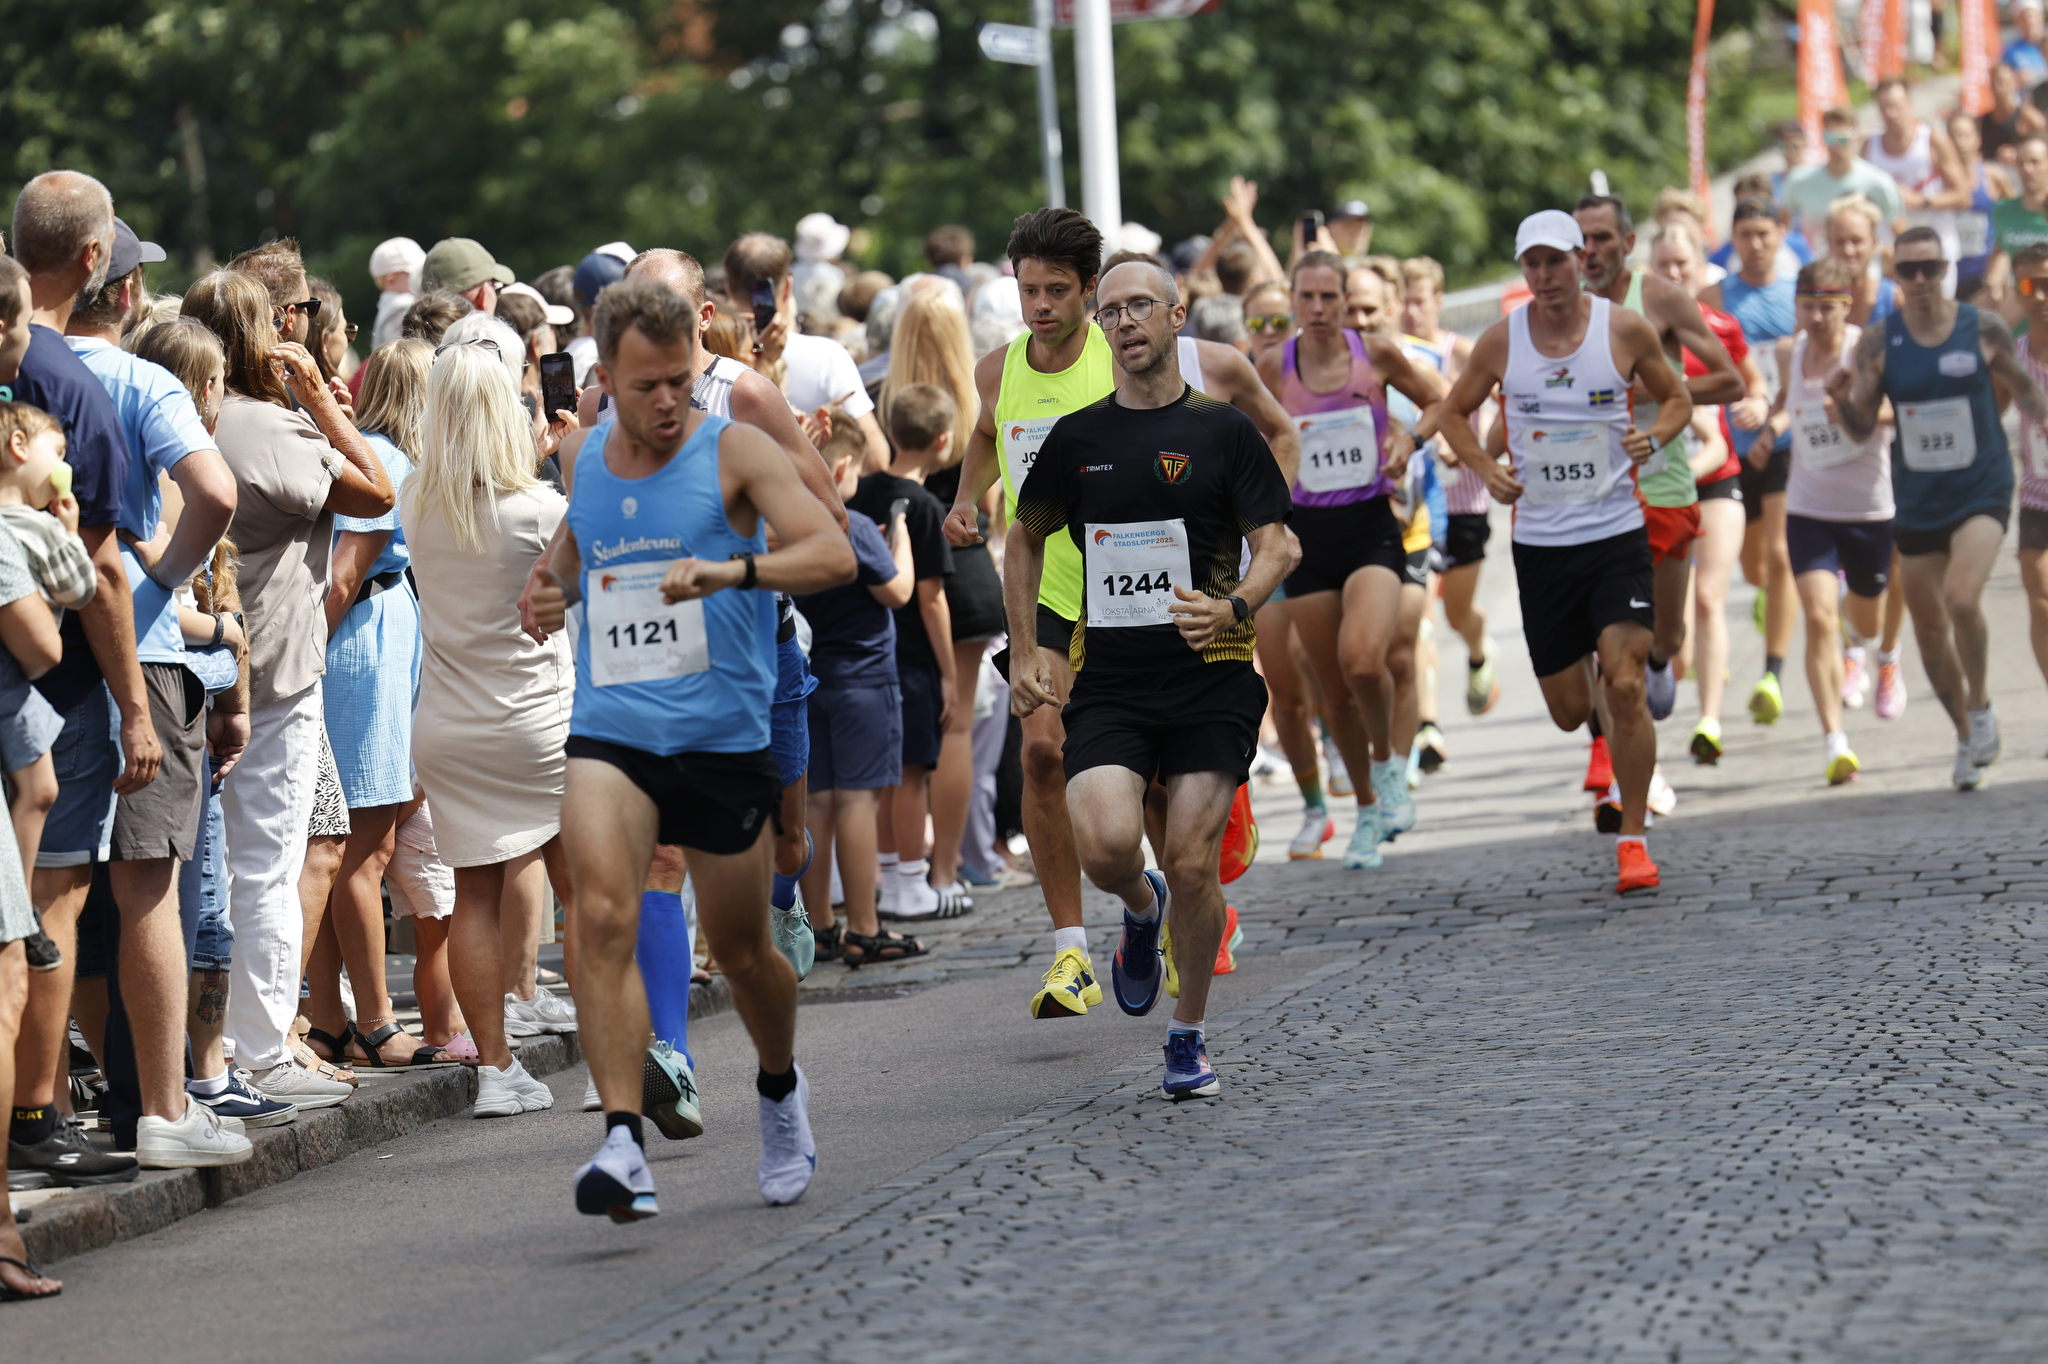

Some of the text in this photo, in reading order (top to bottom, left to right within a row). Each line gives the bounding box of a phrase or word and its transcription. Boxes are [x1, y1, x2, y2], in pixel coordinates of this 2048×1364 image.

[1021, 451, 1039, 464] JO
[1086, 463, 1114, 472] TRIMTEX
[1309, 446, 1363, 469] 1118
[1540, 462, 1596, 482] 1353
[1112, 530, 1166, 540] FALKENBERGS
[591, 536, 681, 566] Studenterna
[1103, 571, 1172, 596] 1244
[607, 618, 678, 649] 1121
[16, 1109, 44, 1120] CAT
